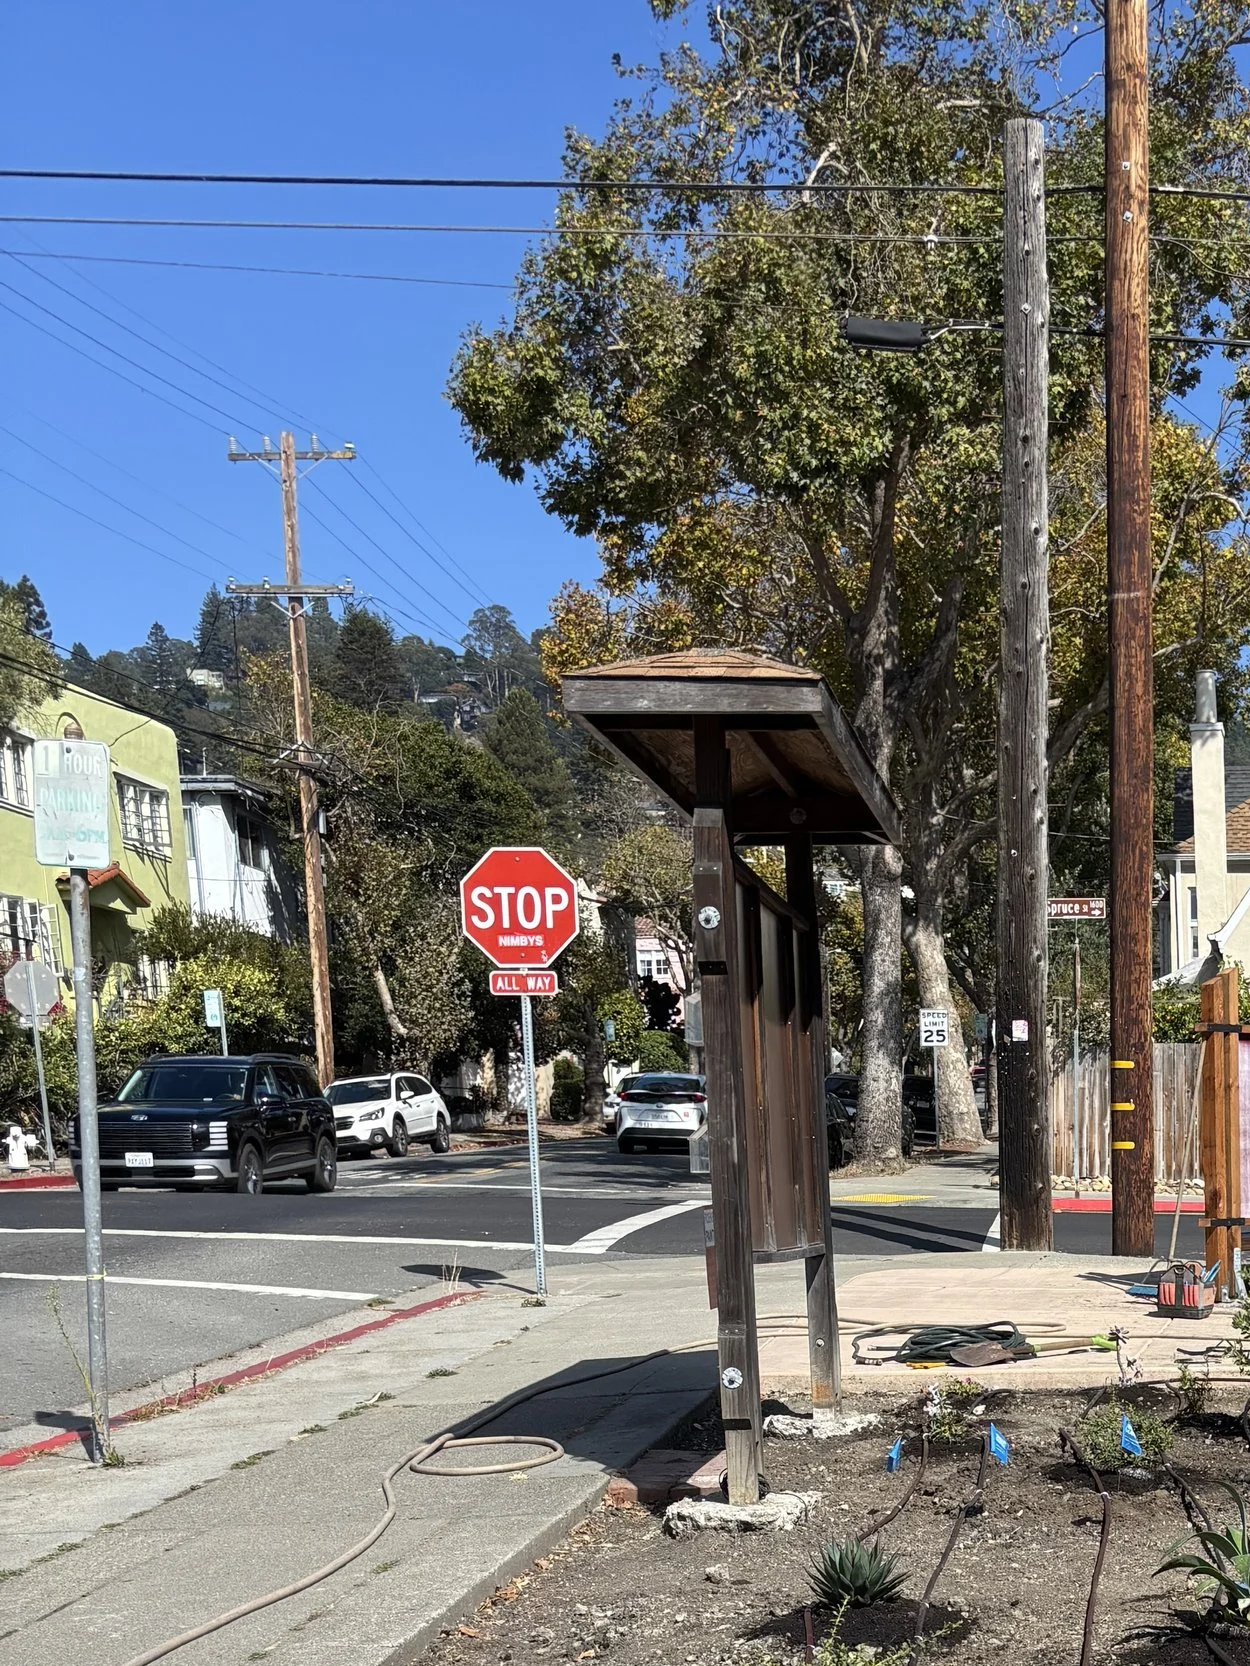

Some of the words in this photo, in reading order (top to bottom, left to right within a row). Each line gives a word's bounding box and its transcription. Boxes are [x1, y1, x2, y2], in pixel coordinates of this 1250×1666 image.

[65, 755, 101, 777] HOUR
[470, 885, 569, 930] STOP
[497, 934, 545, 947] NIMBYS
[496, 976, 520, 991] ALL
[526, 976, 552, 991] WAY
[923, 1029, 946, 1043] 25
